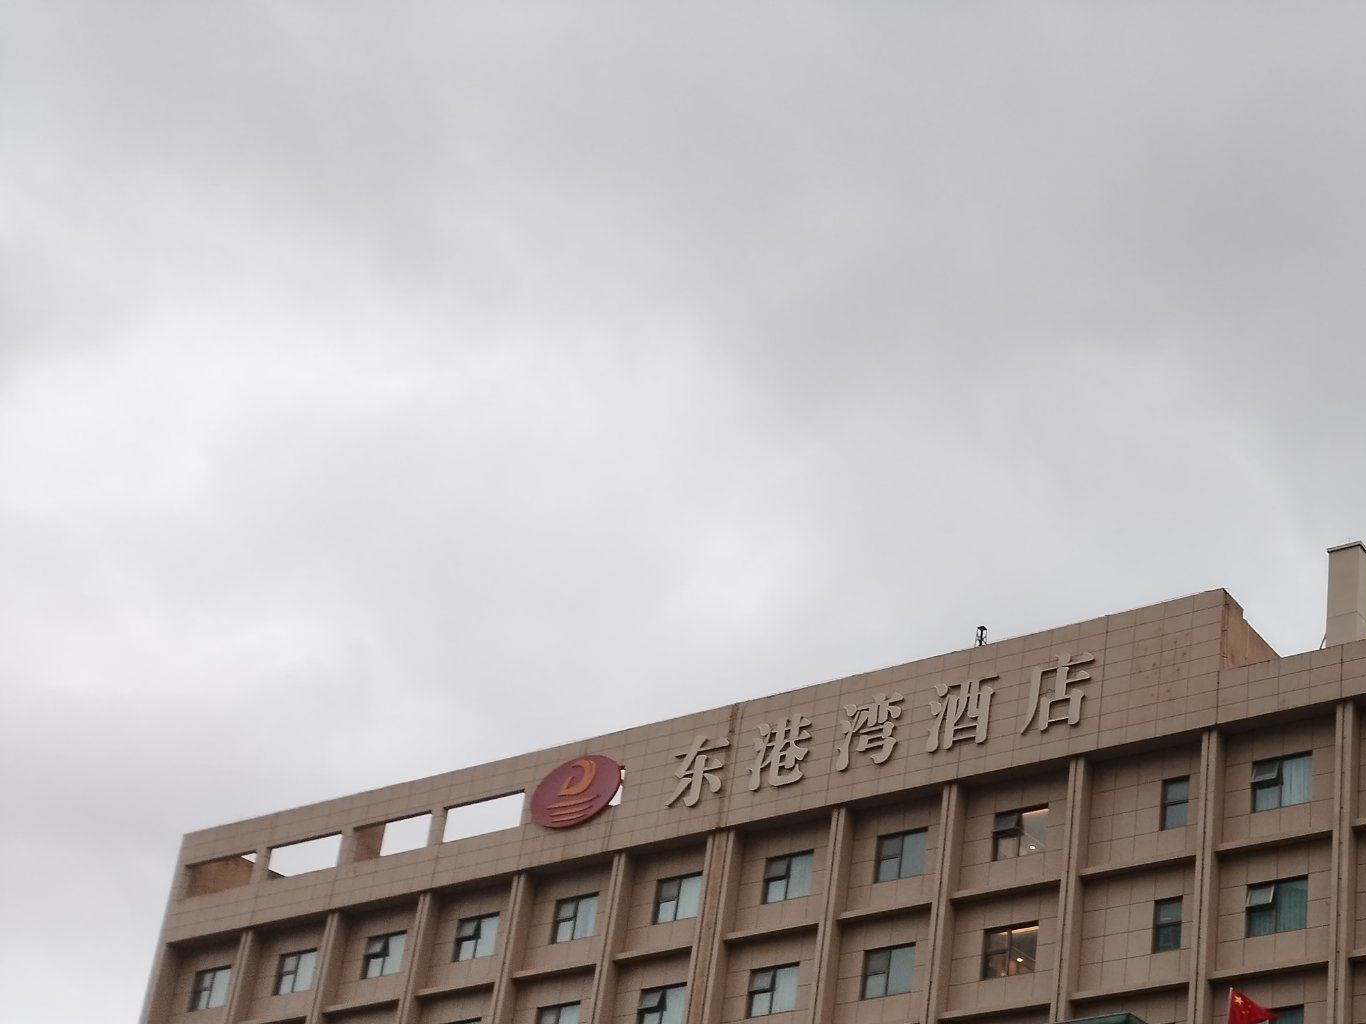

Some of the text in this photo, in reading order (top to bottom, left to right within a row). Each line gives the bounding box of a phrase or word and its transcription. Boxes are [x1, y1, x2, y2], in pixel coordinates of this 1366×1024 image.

[666, 652, 1096, 808] 东港湾酒店
